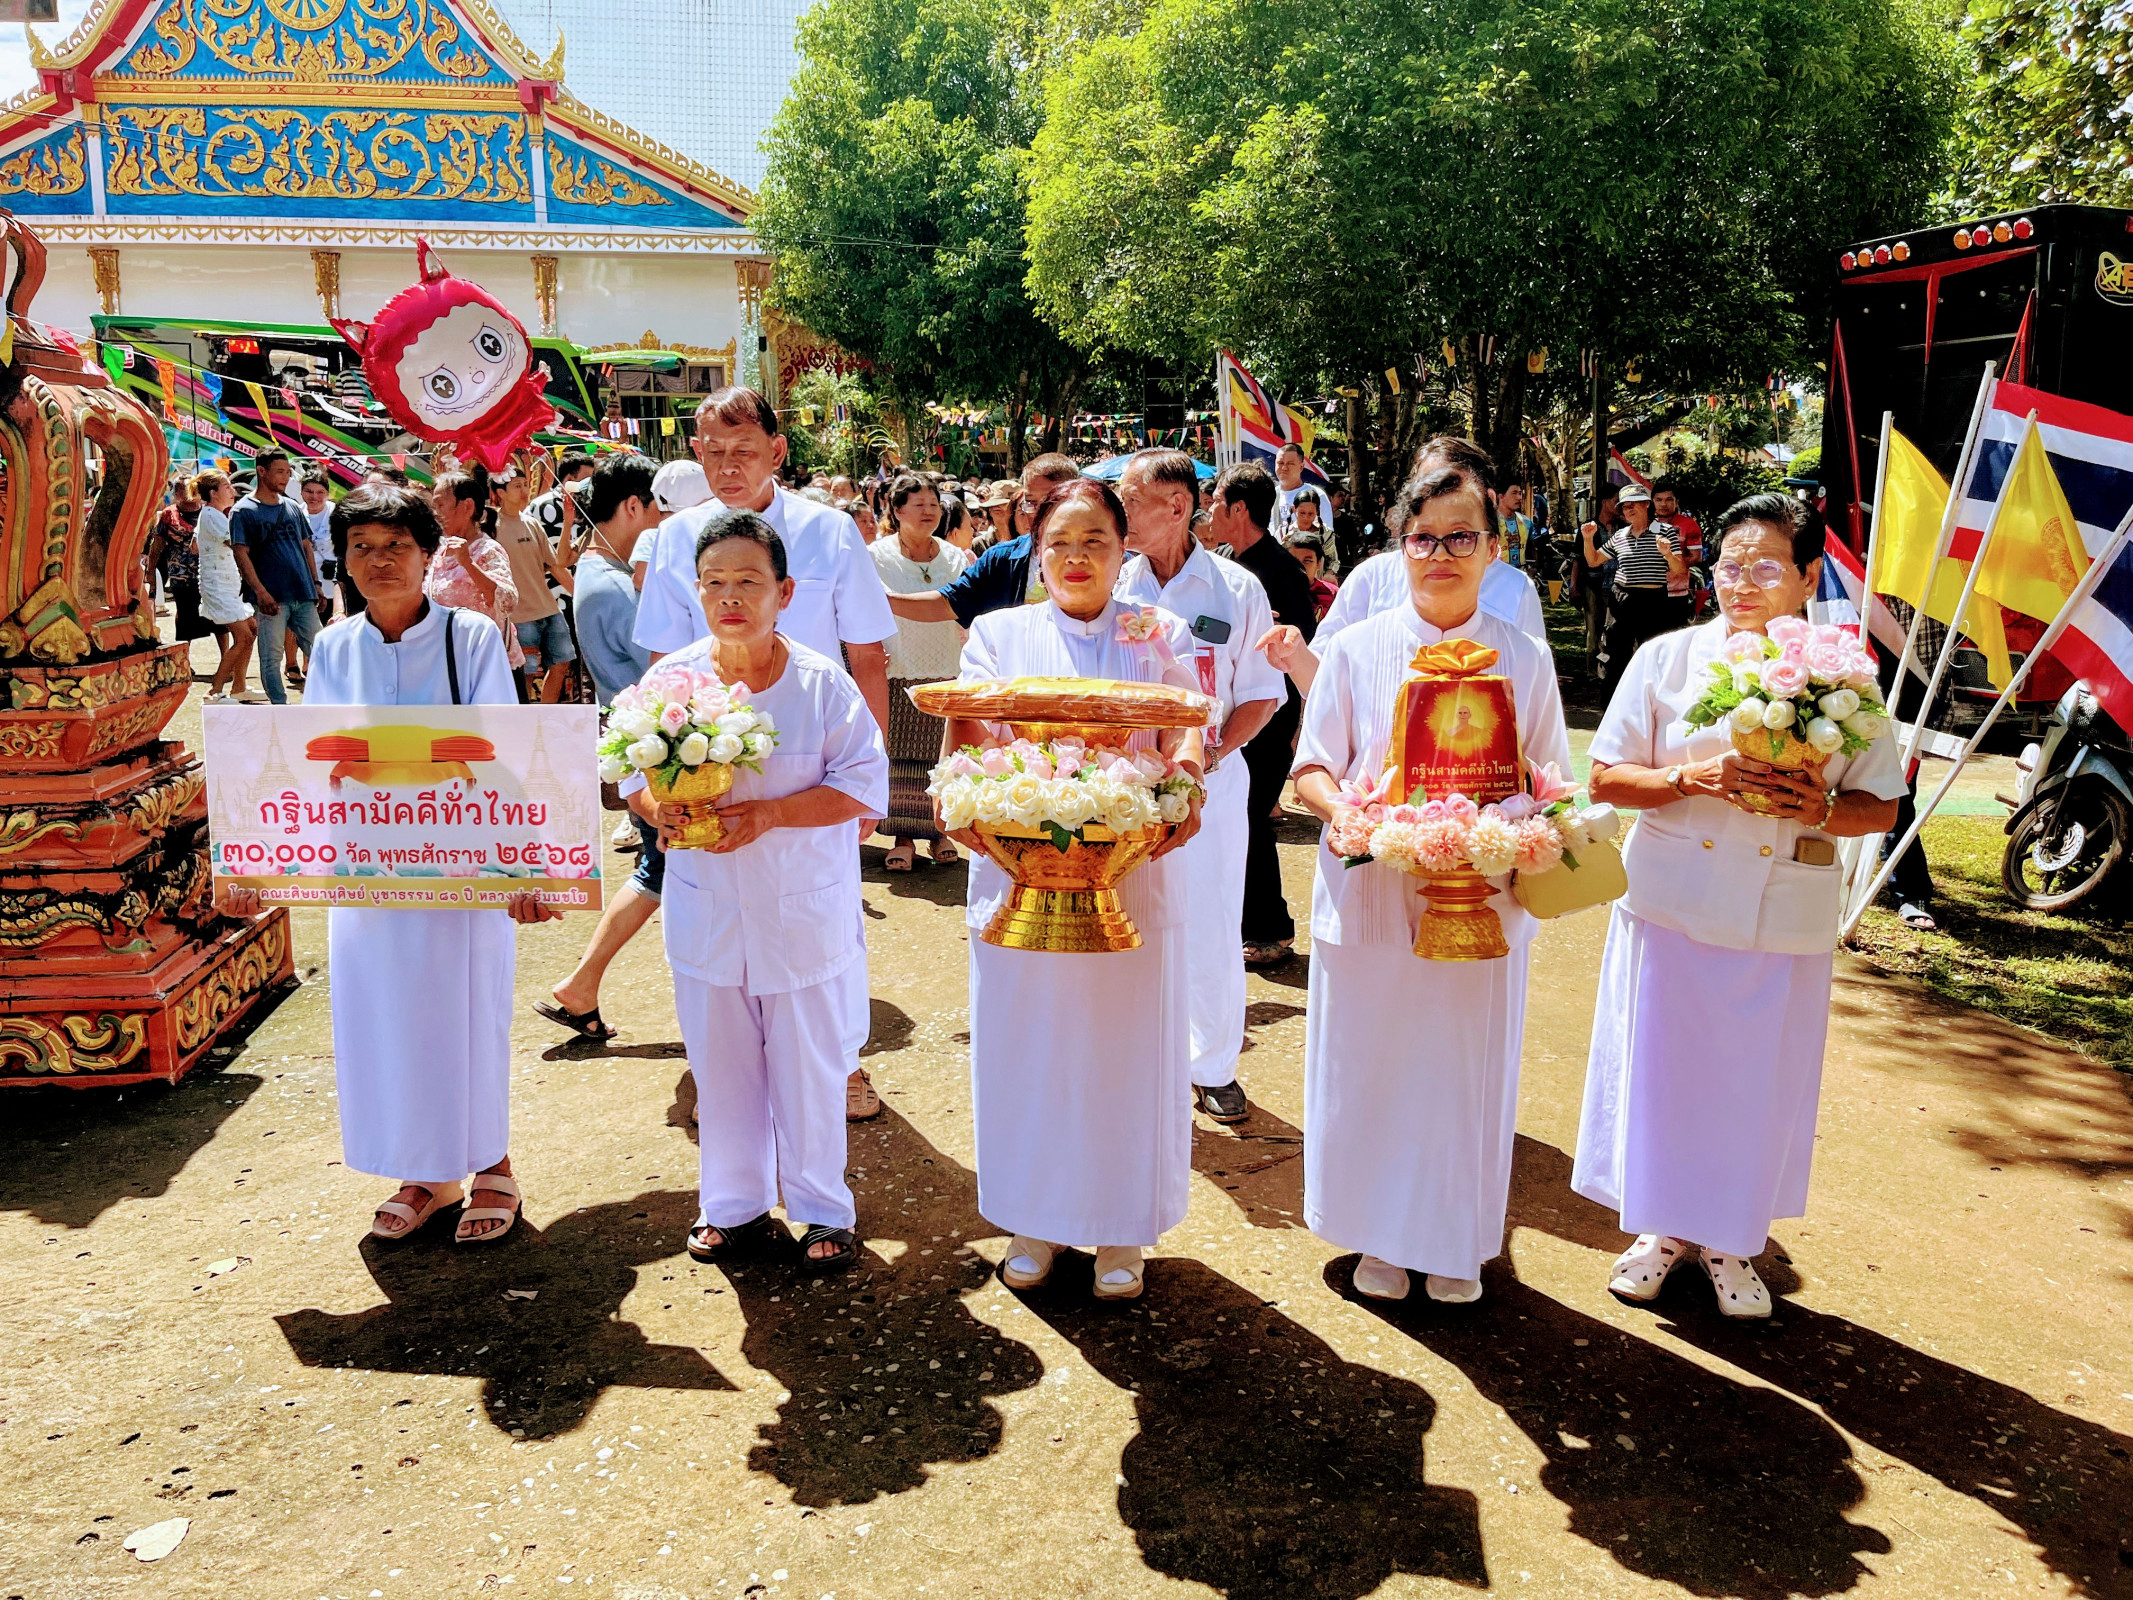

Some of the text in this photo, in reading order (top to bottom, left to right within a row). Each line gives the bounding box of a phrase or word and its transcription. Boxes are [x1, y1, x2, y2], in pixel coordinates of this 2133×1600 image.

[1411, 759, 1514, 779] กฐินสามัคคีทั่วไทย
[260, 782, 546, 834] กฐินสามัคคีทั่วไทย
[223, 841, 590, 871] ๓๐,๐๐๐ วัด พุทธศักราช ๒๕๖๘
[261, 886, 365, 903] คณะศิษยานุศิษย์
[371, 889, 433, 903] บูชาธรรม
[439, 891, 458, 901] ๘๑
[464, 887, 473, 901] ปี
